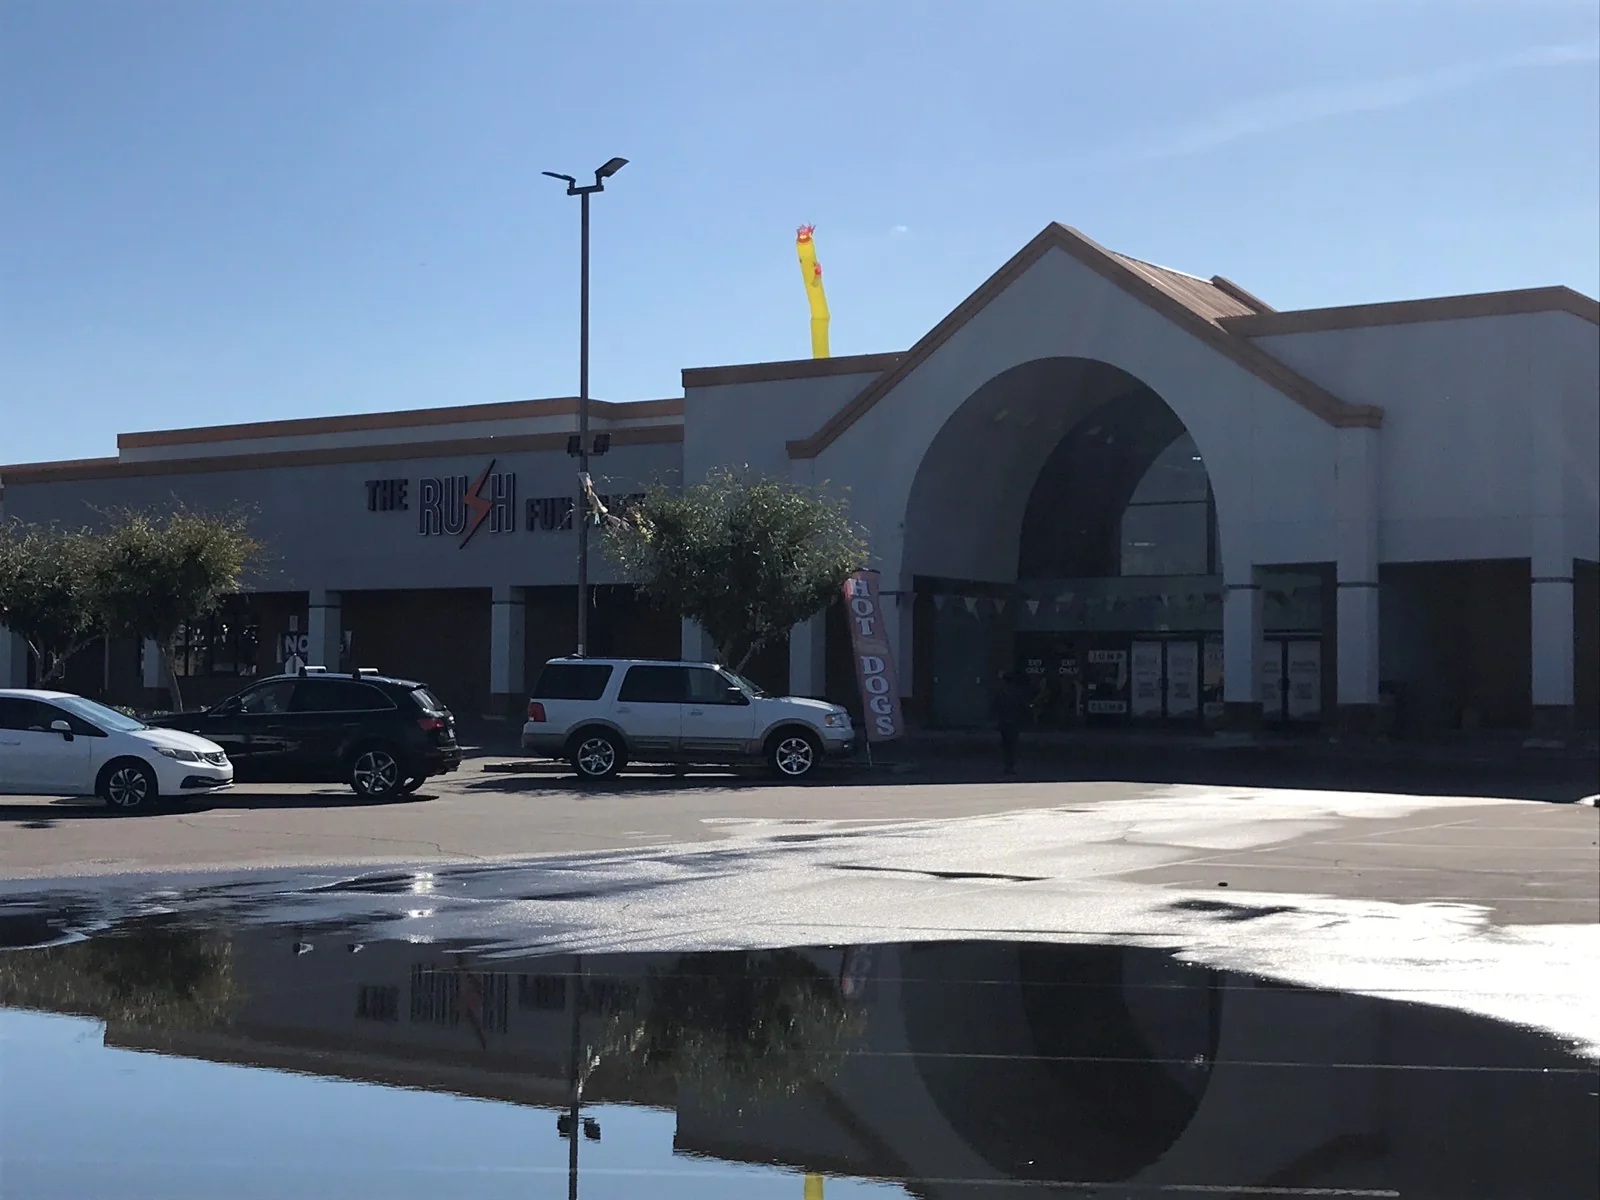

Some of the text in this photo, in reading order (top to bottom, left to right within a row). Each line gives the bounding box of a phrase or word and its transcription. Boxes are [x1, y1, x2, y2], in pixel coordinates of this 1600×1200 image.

[364, 479, 409, 511] THE
[418, 460, 516, 549] RUSH
[525, 496, 573, 531] FUN
[848, 578, 896, 737] HOT DOGS
[1090, 702, 1124, 711] CLIMB
